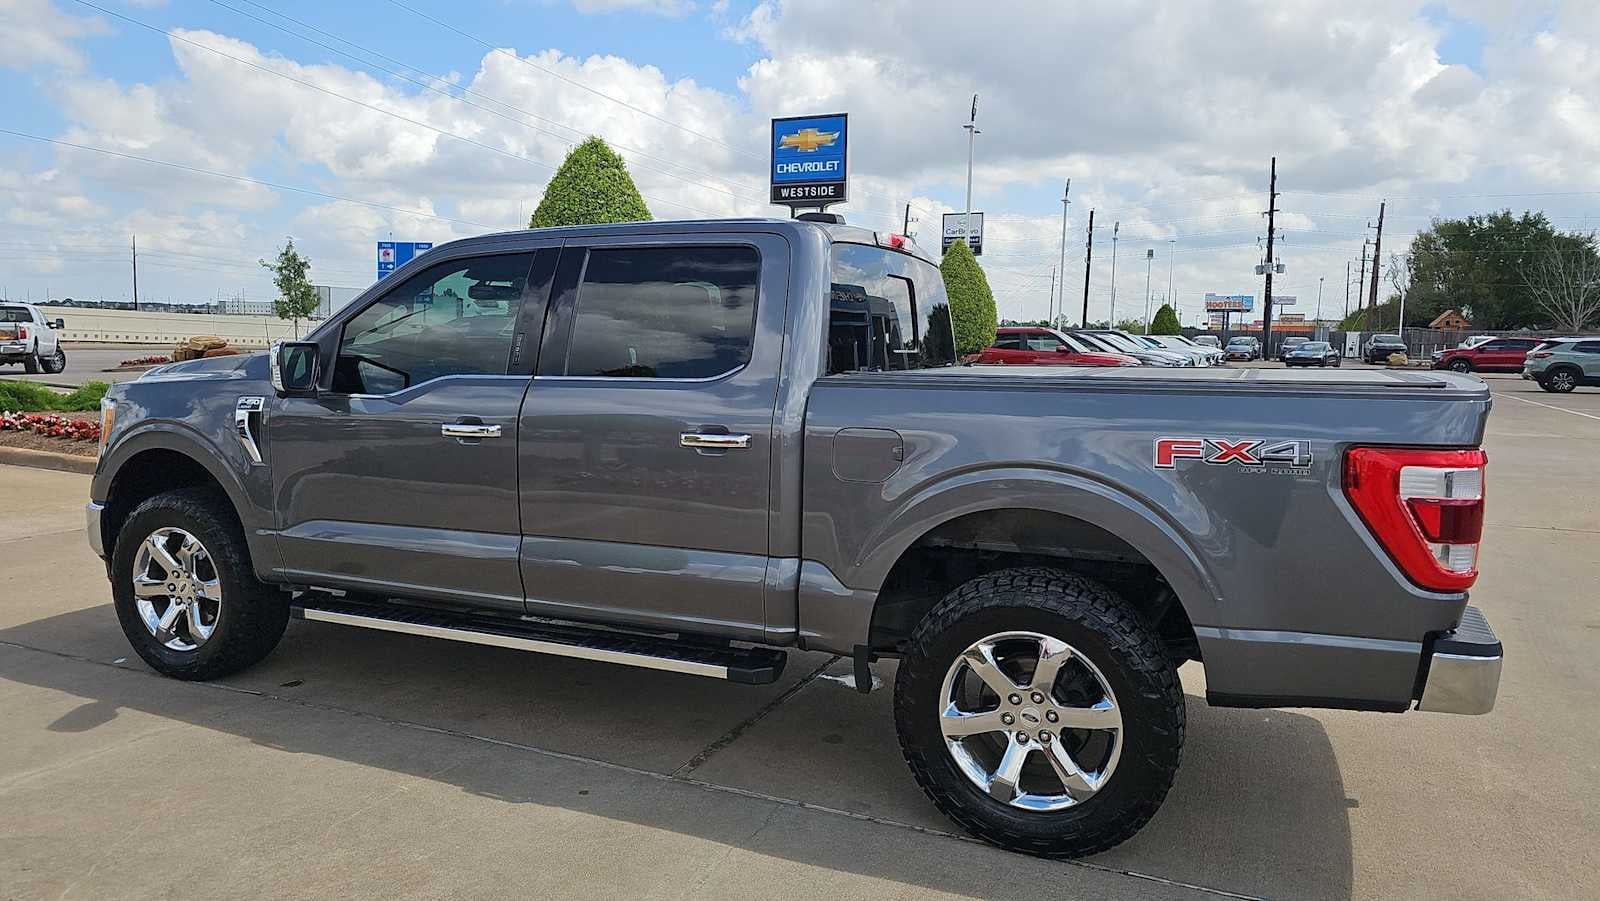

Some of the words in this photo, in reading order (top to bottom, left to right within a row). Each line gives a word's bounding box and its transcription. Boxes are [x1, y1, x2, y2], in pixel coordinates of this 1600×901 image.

[777, 161, 840, 173] CHEVROLET
[781, 186, 835, 197] WESTSIDE
[1153, 438, 1314, 470] FX4
